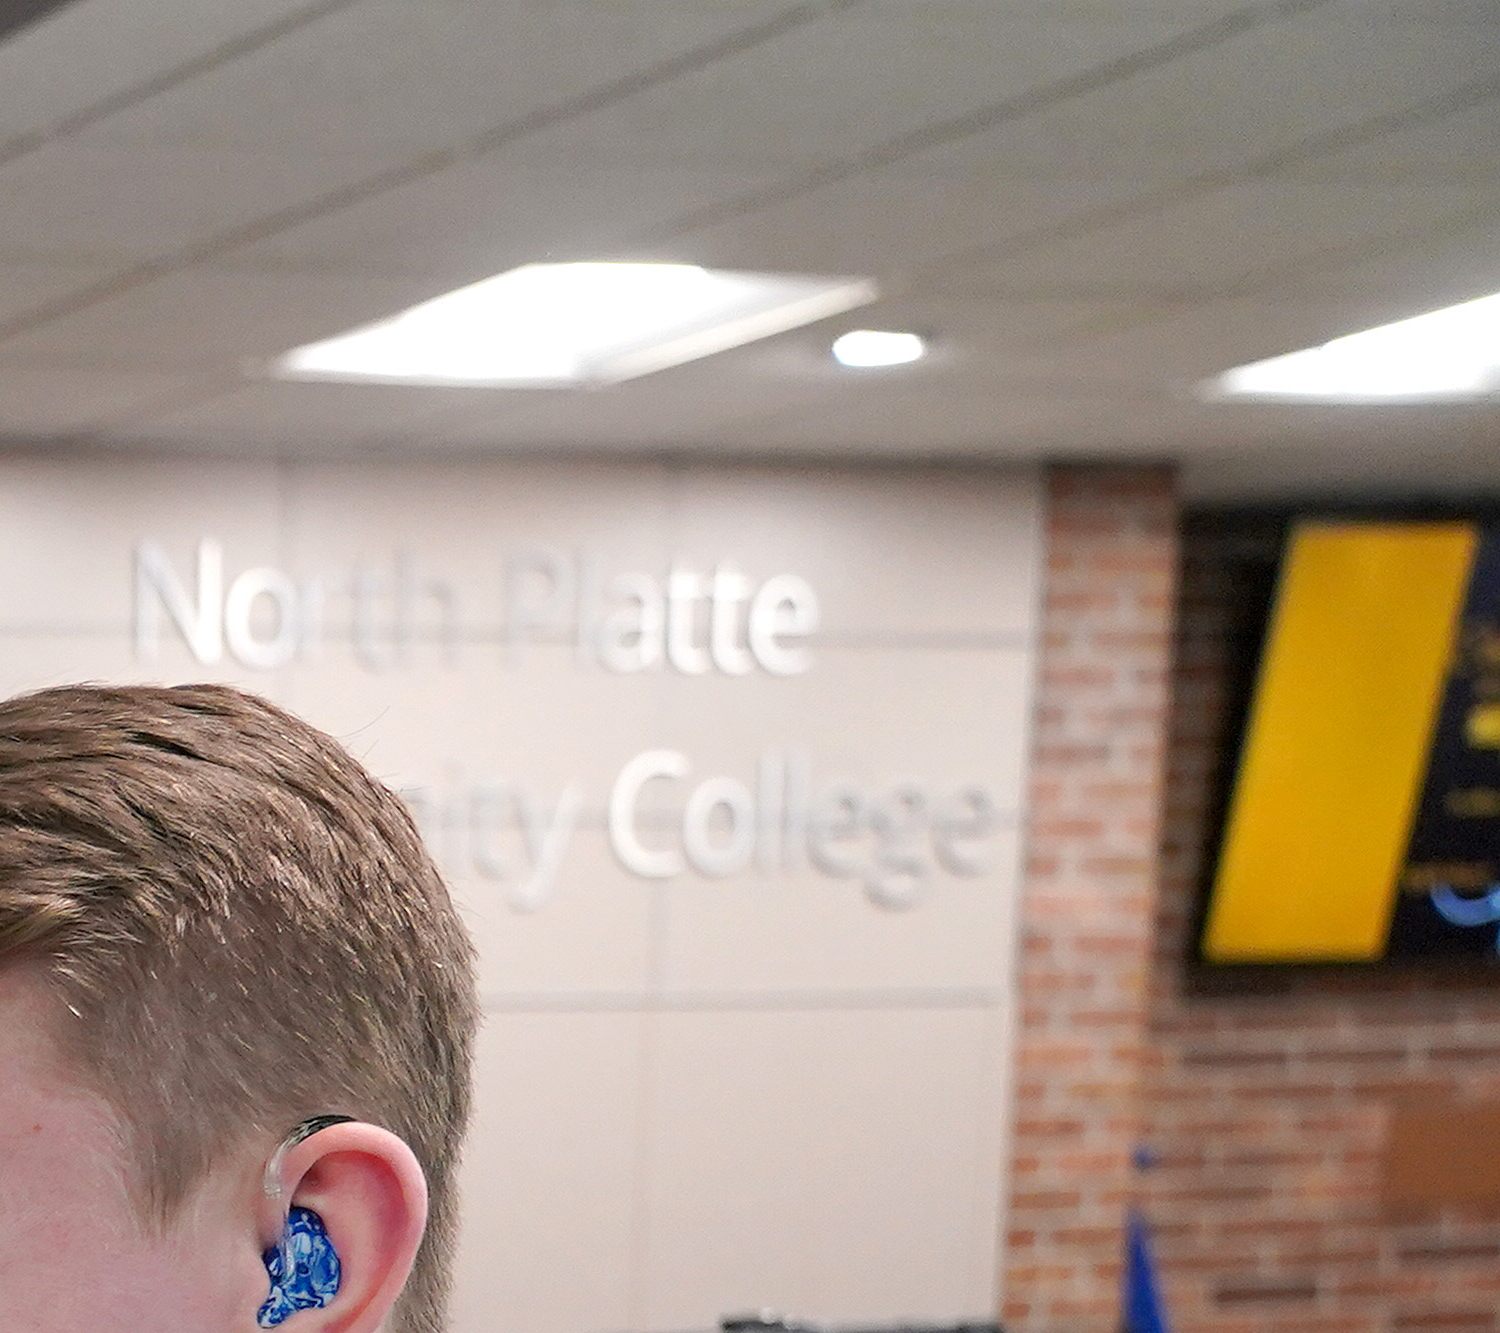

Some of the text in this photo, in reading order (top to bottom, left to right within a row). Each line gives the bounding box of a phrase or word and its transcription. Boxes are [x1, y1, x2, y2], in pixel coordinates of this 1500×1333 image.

[133, 534, 822, 678] North Platte
[606, 746, 997, 914] College
